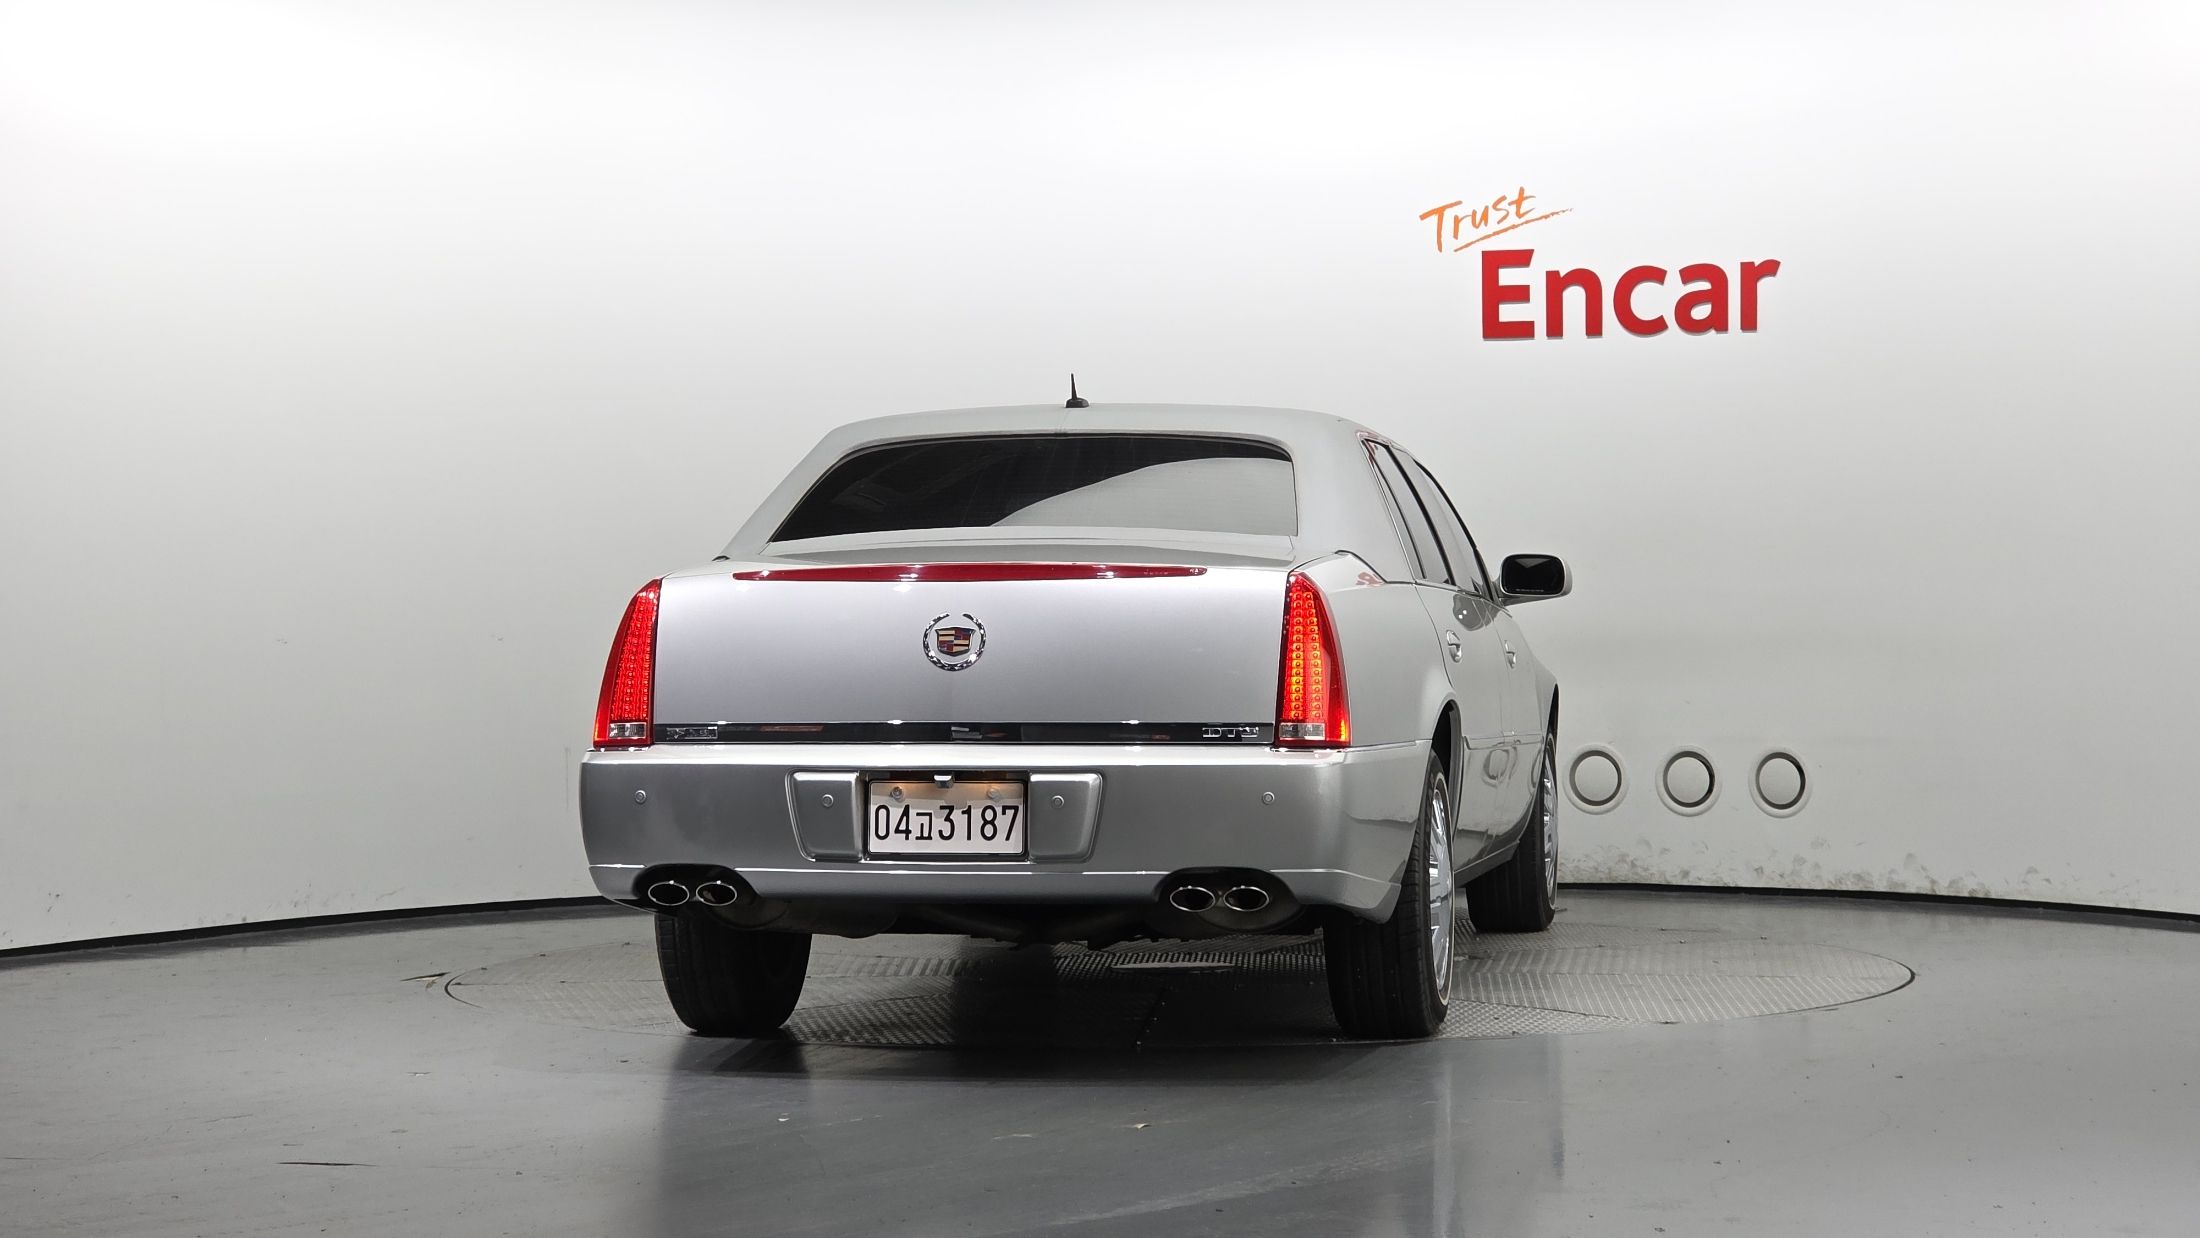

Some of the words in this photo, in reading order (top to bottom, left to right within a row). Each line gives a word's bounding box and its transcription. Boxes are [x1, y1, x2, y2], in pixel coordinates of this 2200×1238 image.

[1419, 186, 1537, 253] Trust
[1481, 248, 1781, 340] Encar
[1202, 727, 1259, 738] DTS
[874, 803, 1020, 842] 04고3187
